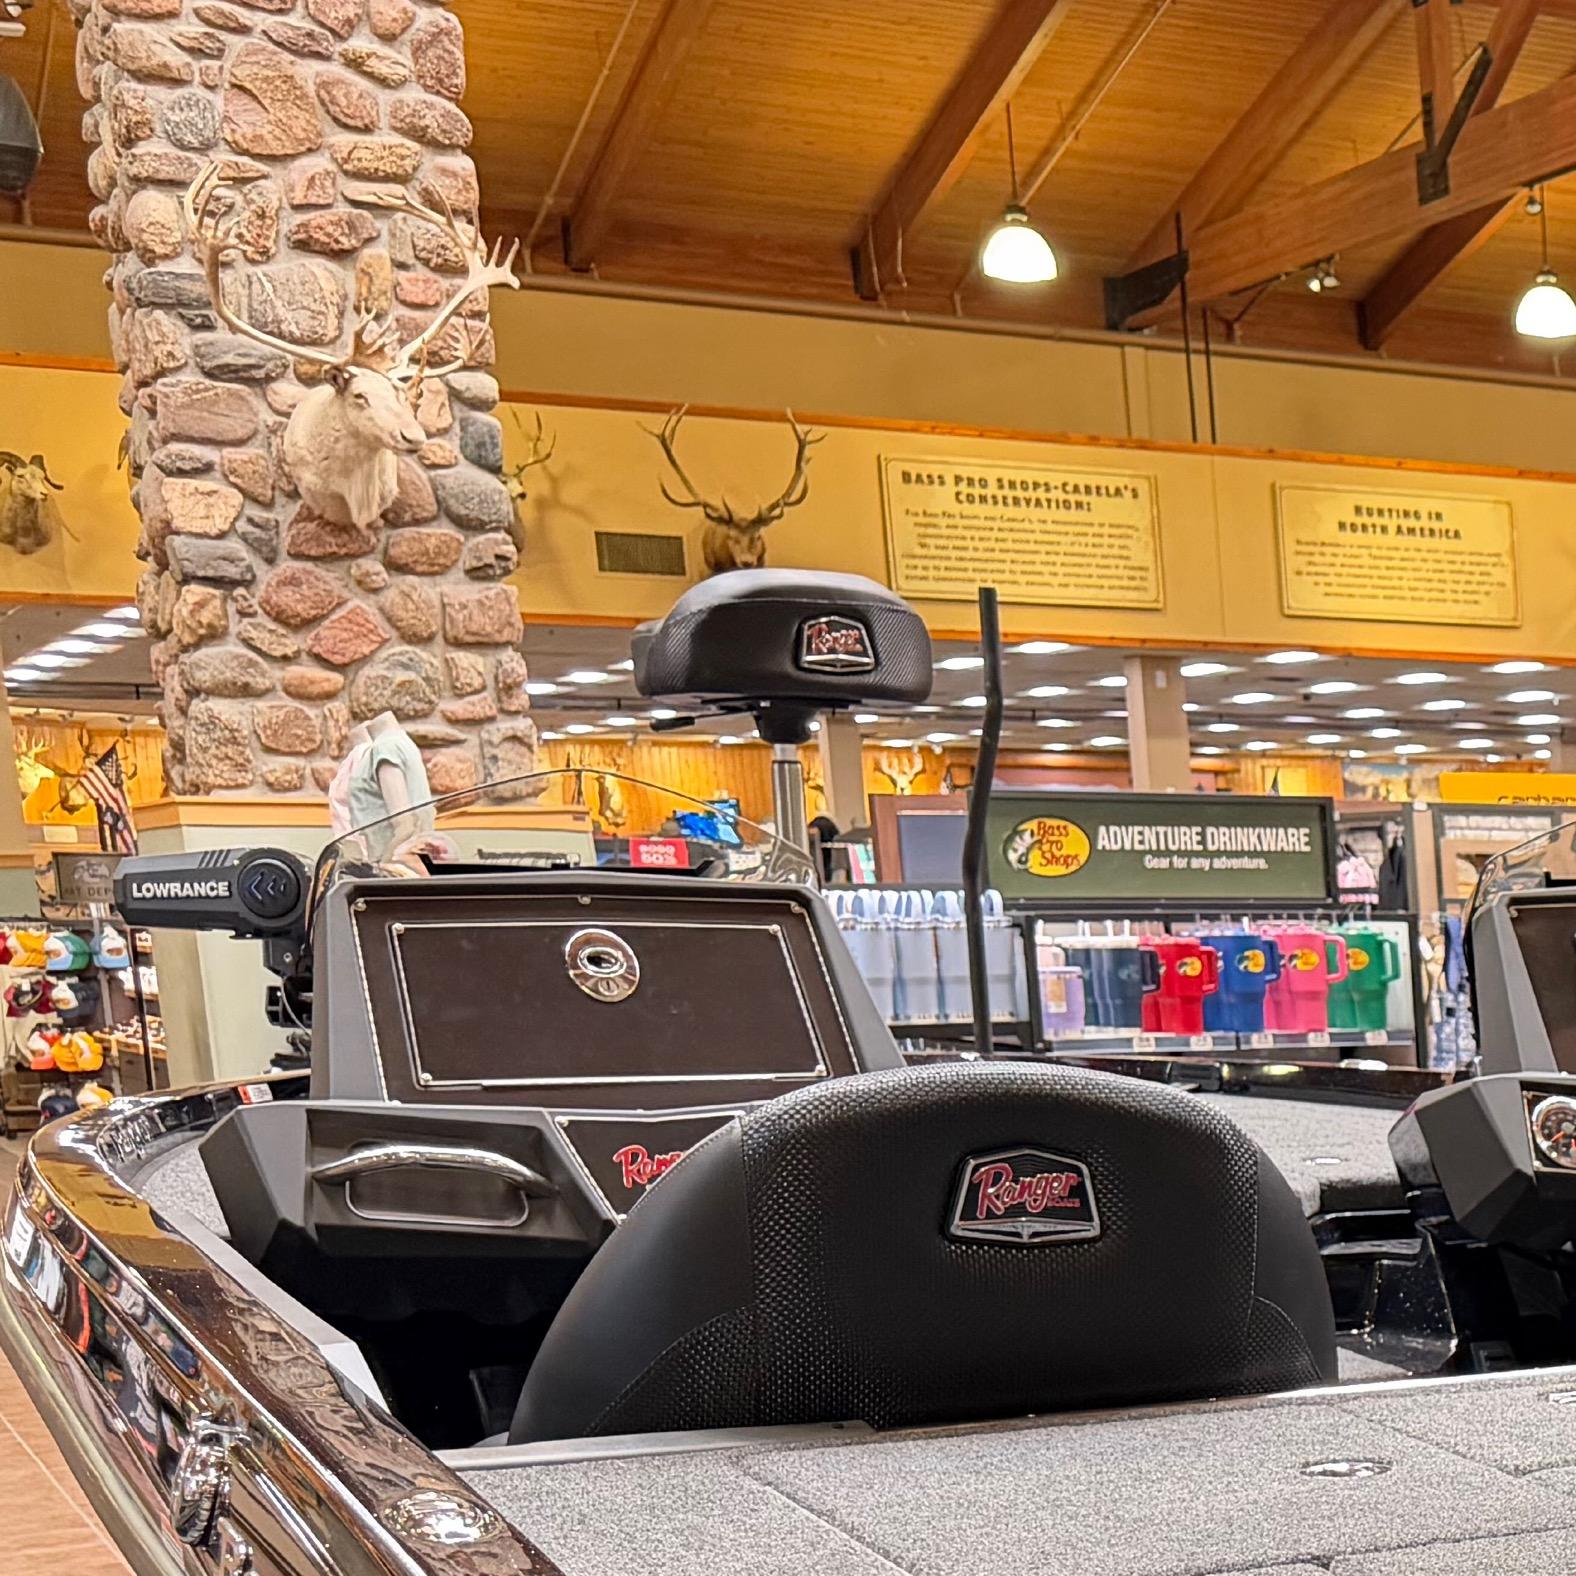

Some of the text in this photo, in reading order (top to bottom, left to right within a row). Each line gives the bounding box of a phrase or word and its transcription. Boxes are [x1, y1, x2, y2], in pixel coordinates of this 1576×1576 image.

[901, 470, 947, 487] BASS
[954, 474, 989, 490] PRO
[1354, 504, 1444, 522] HUNTING IN
[1337, 520, 1462, 540] NORTH AMERICA
[1037, 820, 1069, 838] Bass
[1097, 824, 1311, 853] ADVENTURE DRINKWARE
[1040, 851, 1081, 869] Shops
[1143, 854, 1170, 870] Gear
[1172, 854, 1188, 869] for
[1190, 857, 1211, 872] any
[131, 880, 230, 899] LOWRANCE
[971, 1162, 1079, 1219] Ranger
